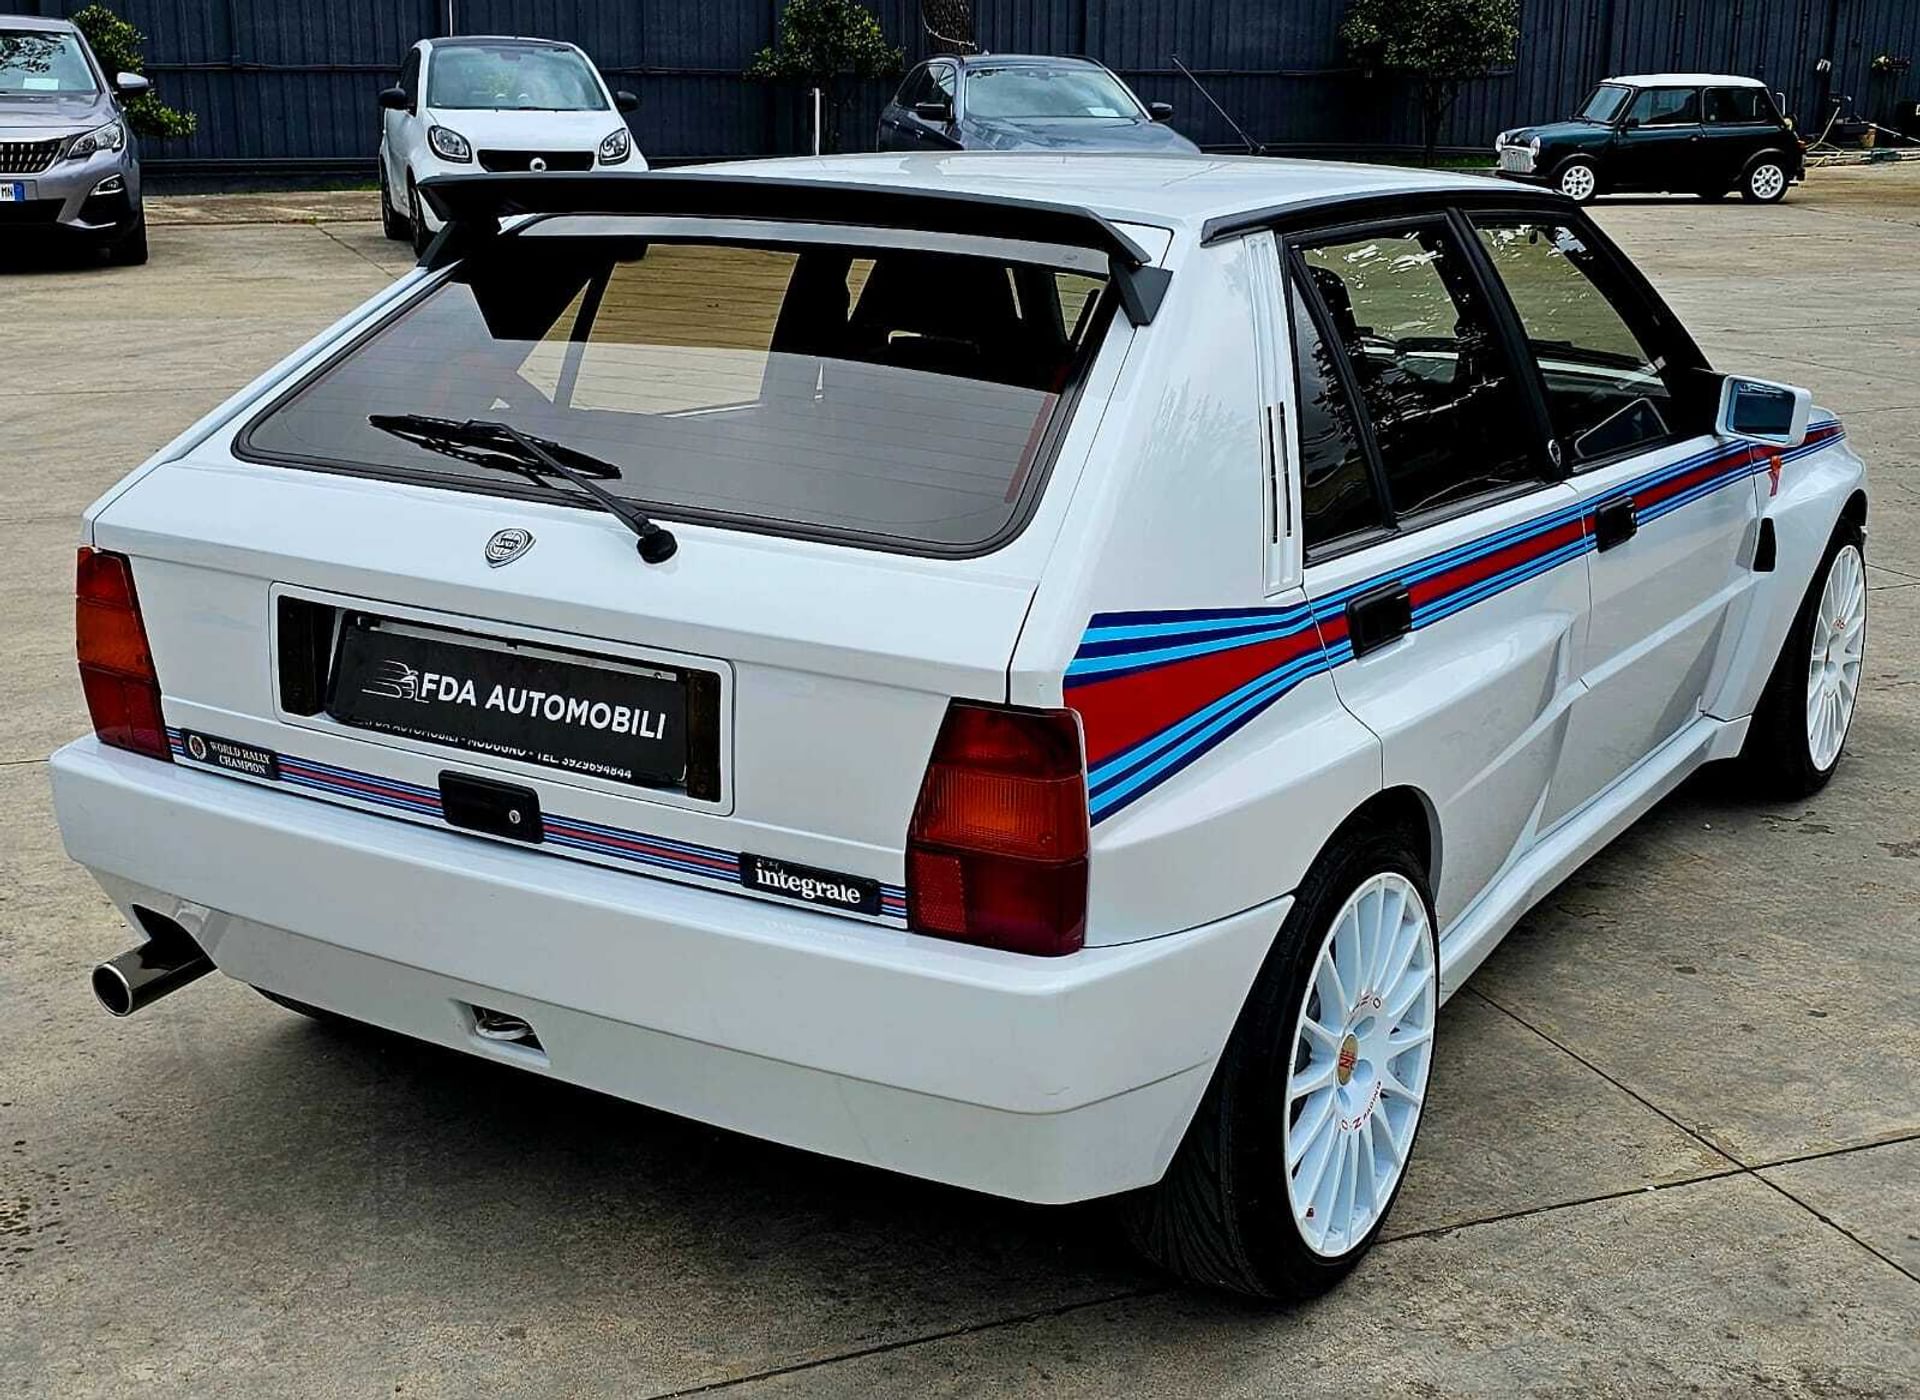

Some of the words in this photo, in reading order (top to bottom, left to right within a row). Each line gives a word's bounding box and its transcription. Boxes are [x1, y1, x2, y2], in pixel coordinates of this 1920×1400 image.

[421, 672, 476, 707] FDA
[485, 684, 668, 740] AUTOMOBILI
[209, 741, 241, 757] WORLD
[241, 749, 271, 765] RALLY
[218, 754, 266, 775] CHAMPION
[755, 862, 862, 904] integrale
